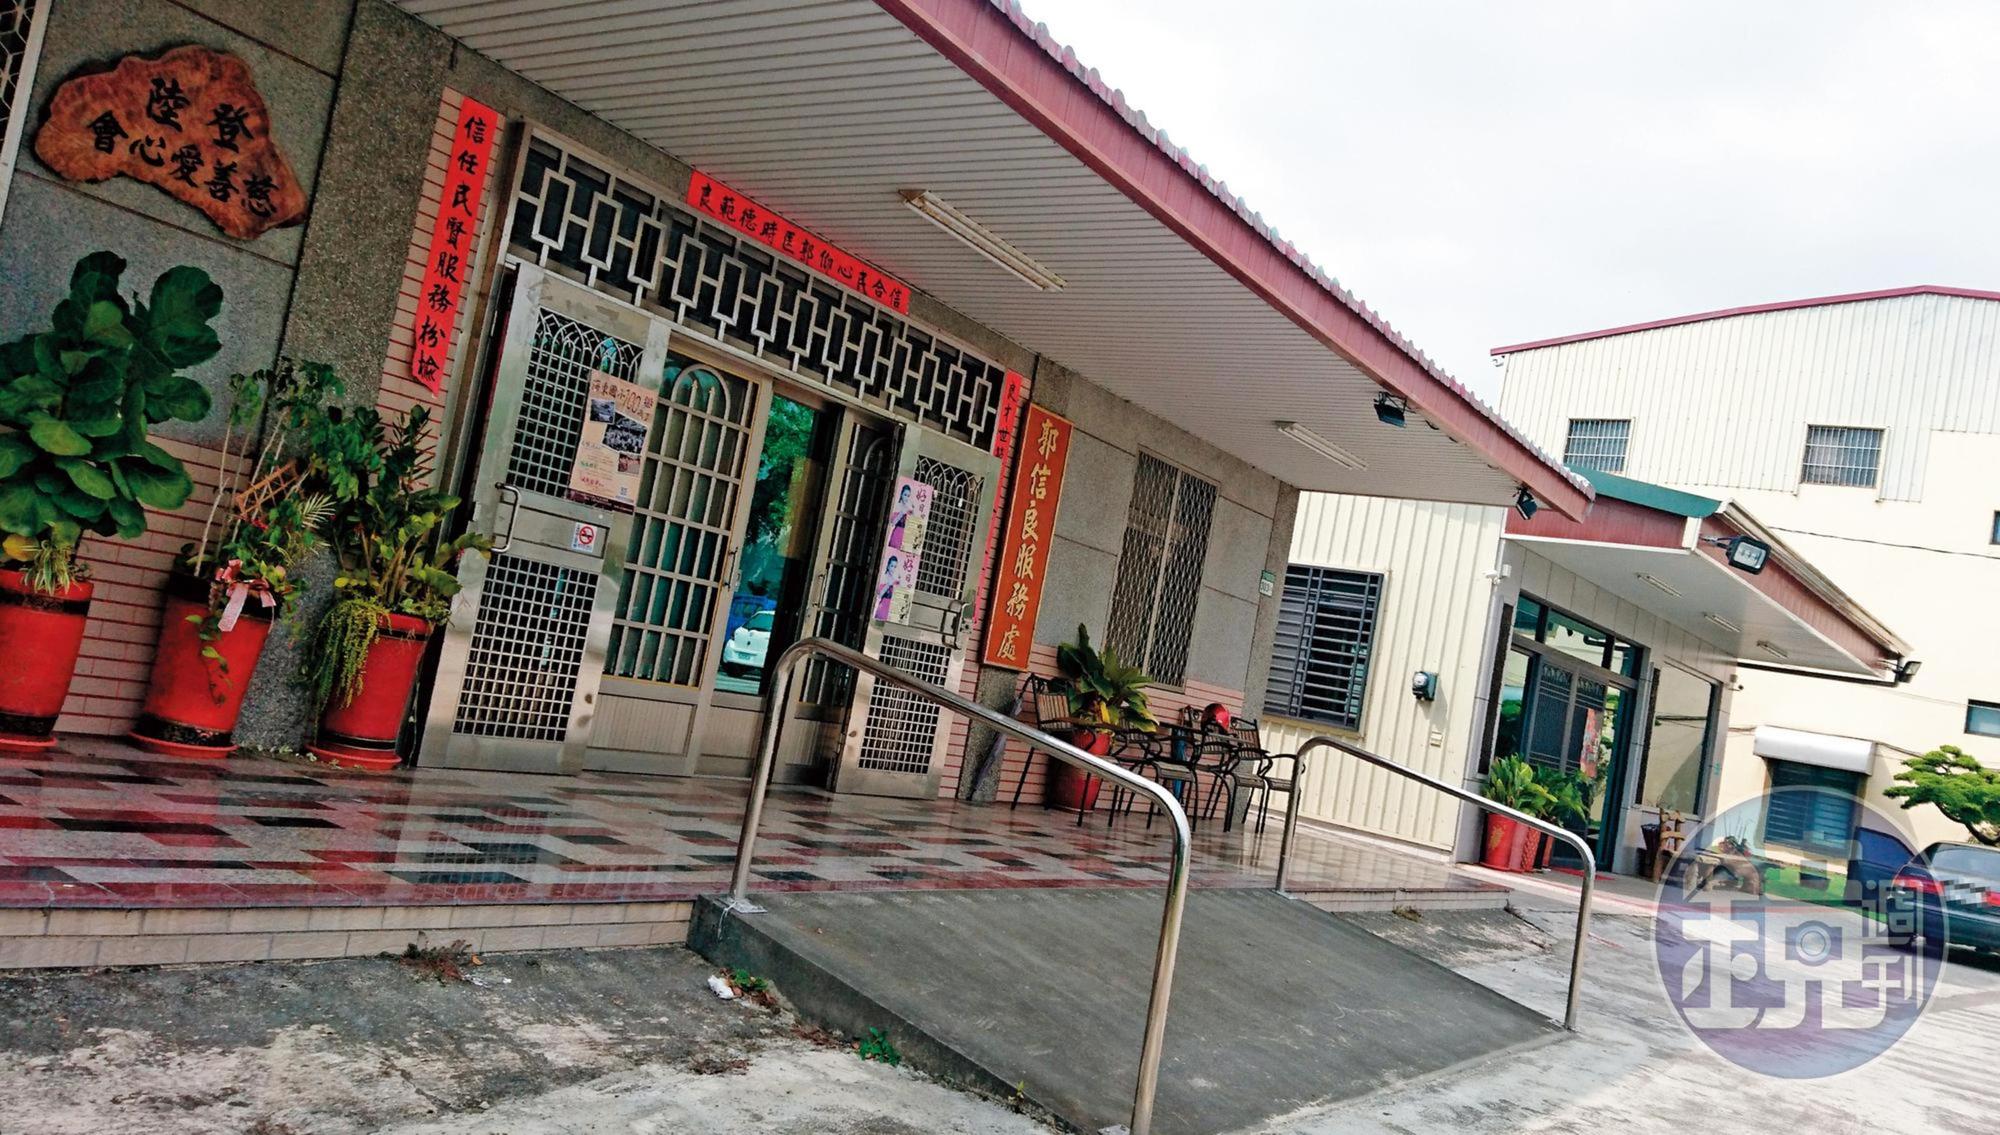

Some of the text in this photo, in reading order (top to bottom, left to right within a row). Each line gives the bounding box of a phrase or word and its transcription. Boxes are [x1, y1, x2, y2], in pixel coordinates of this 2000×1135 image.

[87, 110, 280, 217] 慈善愛心會
[146, 77, 254, 153] 登陸
[997, 419, 1060, 661] 郭信良服務處
